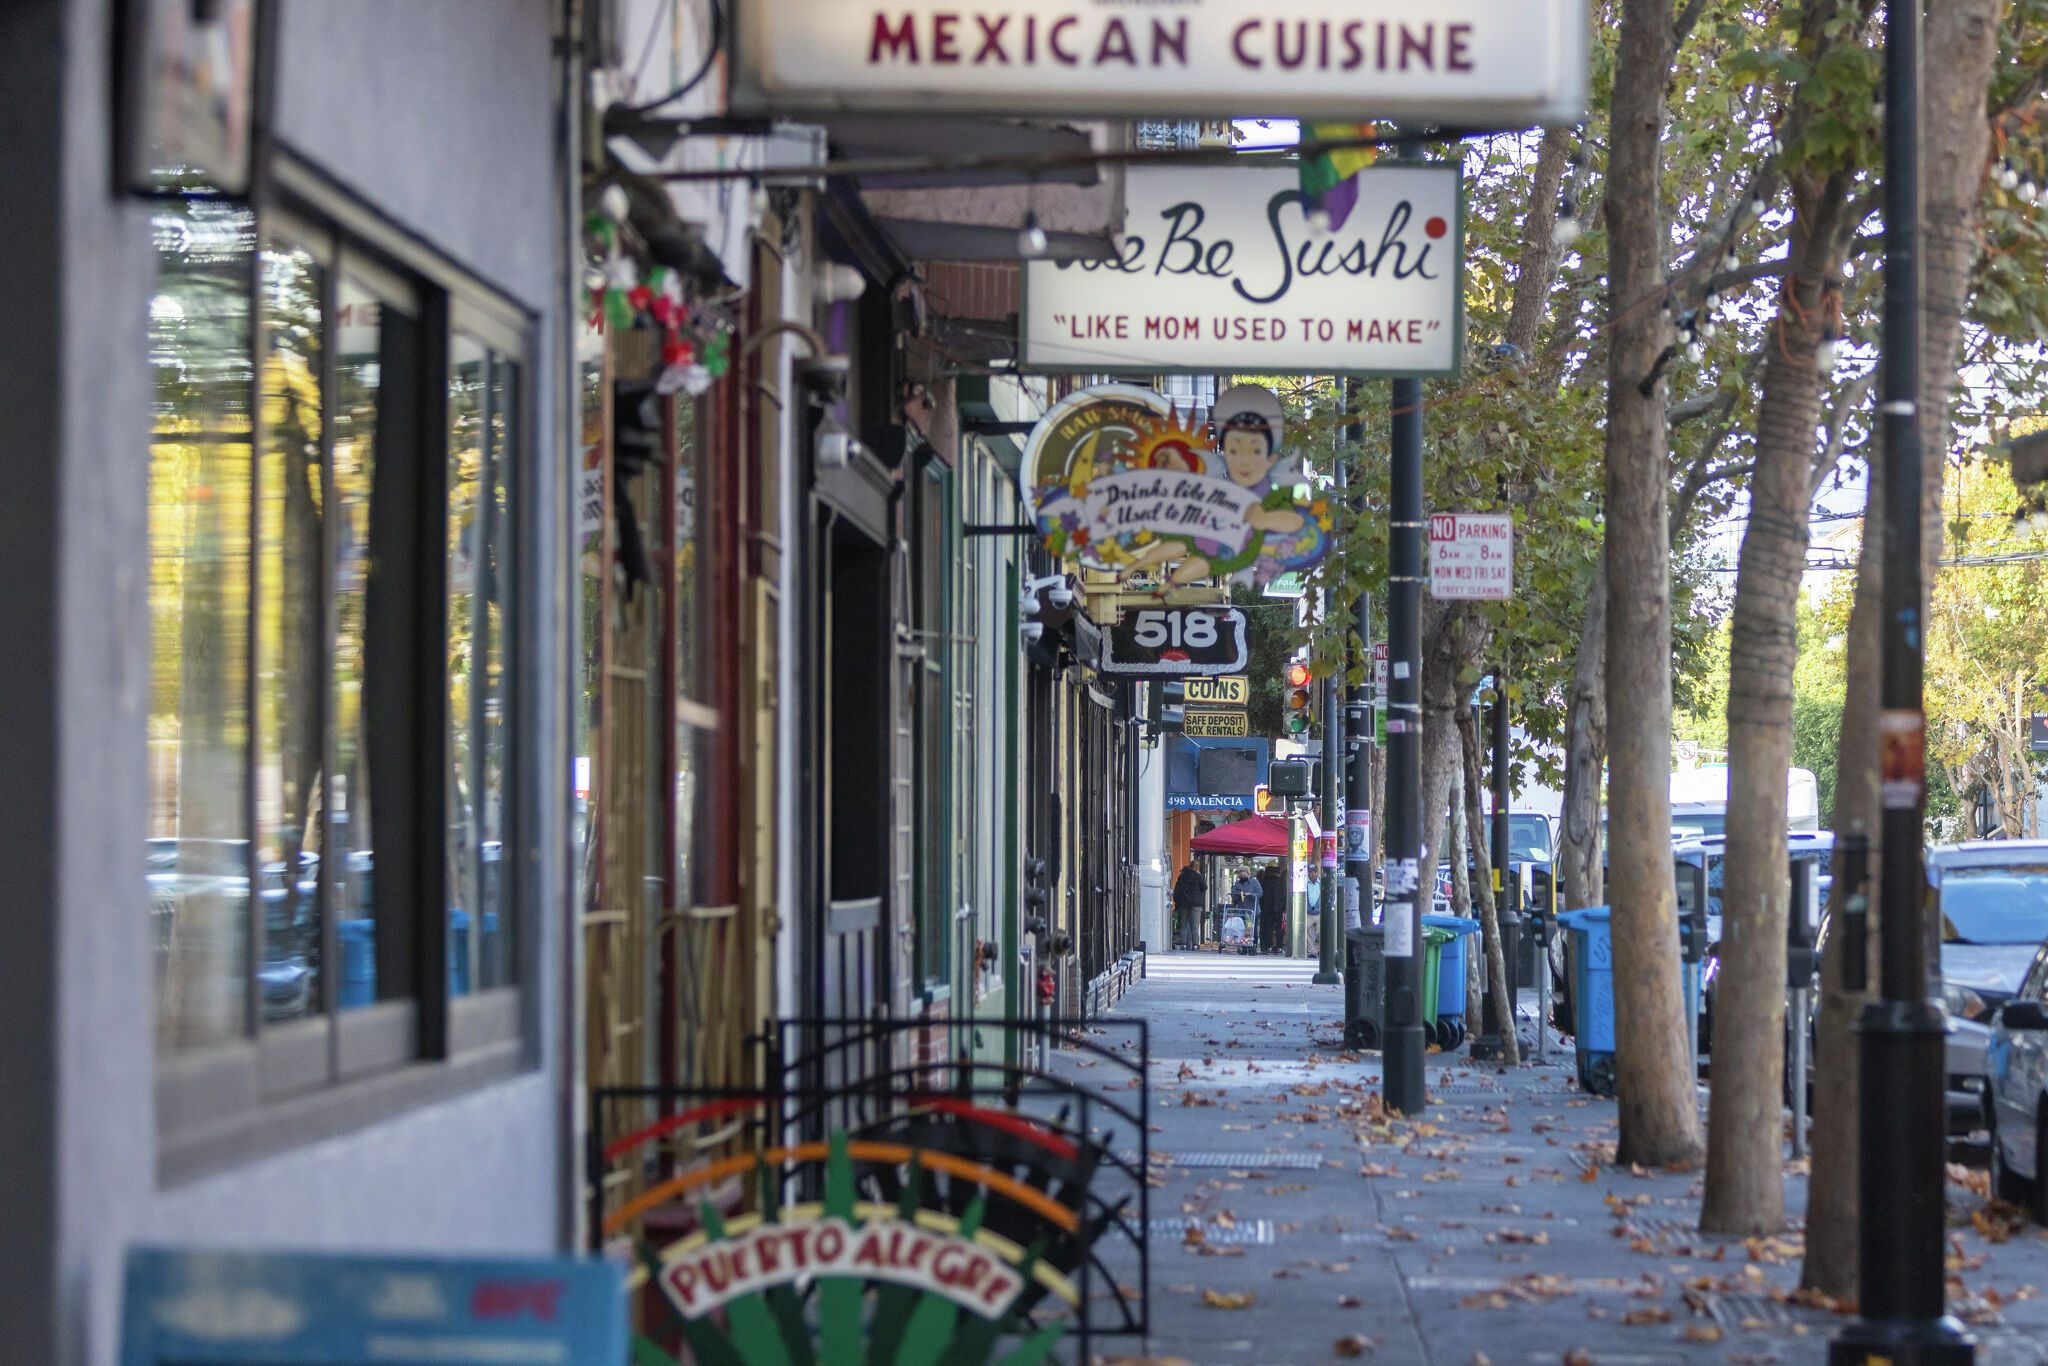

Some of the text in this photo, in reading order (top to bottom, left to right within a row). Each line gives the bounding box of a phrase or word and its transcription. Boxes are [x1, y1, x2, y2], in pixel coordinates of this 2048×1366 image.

[868, 13, 1476, 72] MEXICAN CUISINE
[1155, 202, 1233, 277] Be
[1231, 190, 1447, 304] Sushi
[1054, 314, 1441, 345] "LIKE MOM USED TO MAKE"
[1117, 502, 1162, 525] Used
[1165, 503, 1179, 521] to
[1432, 518, 1507, 540] NO PARKING
[1434, 566, 1506, 580] MON WED FRI SAT
[1134, 610, 1218, 648] 518
[1188, 680, 1240, 701] COINS
[1185, 715, 1244, 726] SAFE DEPOSIT
[1186, 725, 1243, 736] BOX RENTALS
[1168, 796, 1243, 806] 498 VALENCIA
[669, 1226, 1013, 1306] PUERTO ALEGRE
